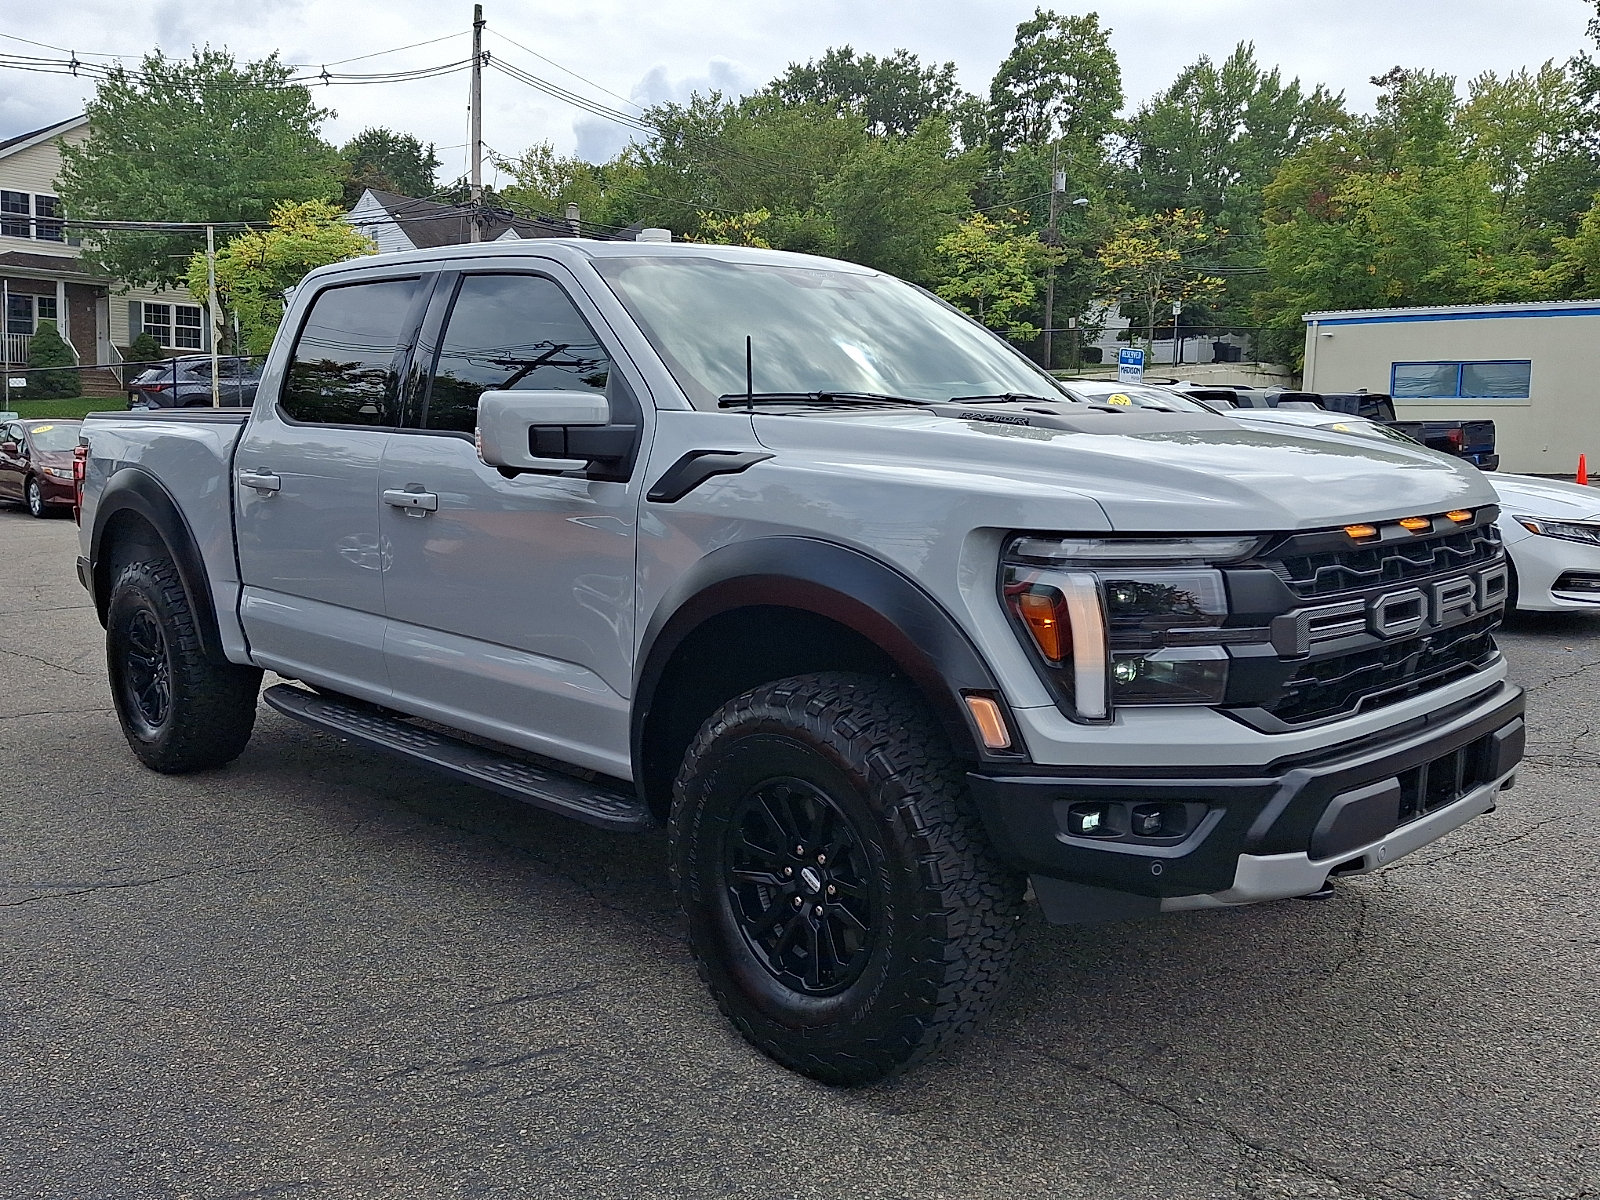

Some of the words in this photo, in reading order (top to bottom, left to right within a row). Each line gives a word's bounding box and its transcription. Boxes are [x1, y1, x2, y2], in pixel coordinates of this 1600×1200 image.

[1120, 366, 1140, 374] MADISON
[961, 411, 1030, 426] RAPTOR
[1293, 562, 1508, 654] FORD
